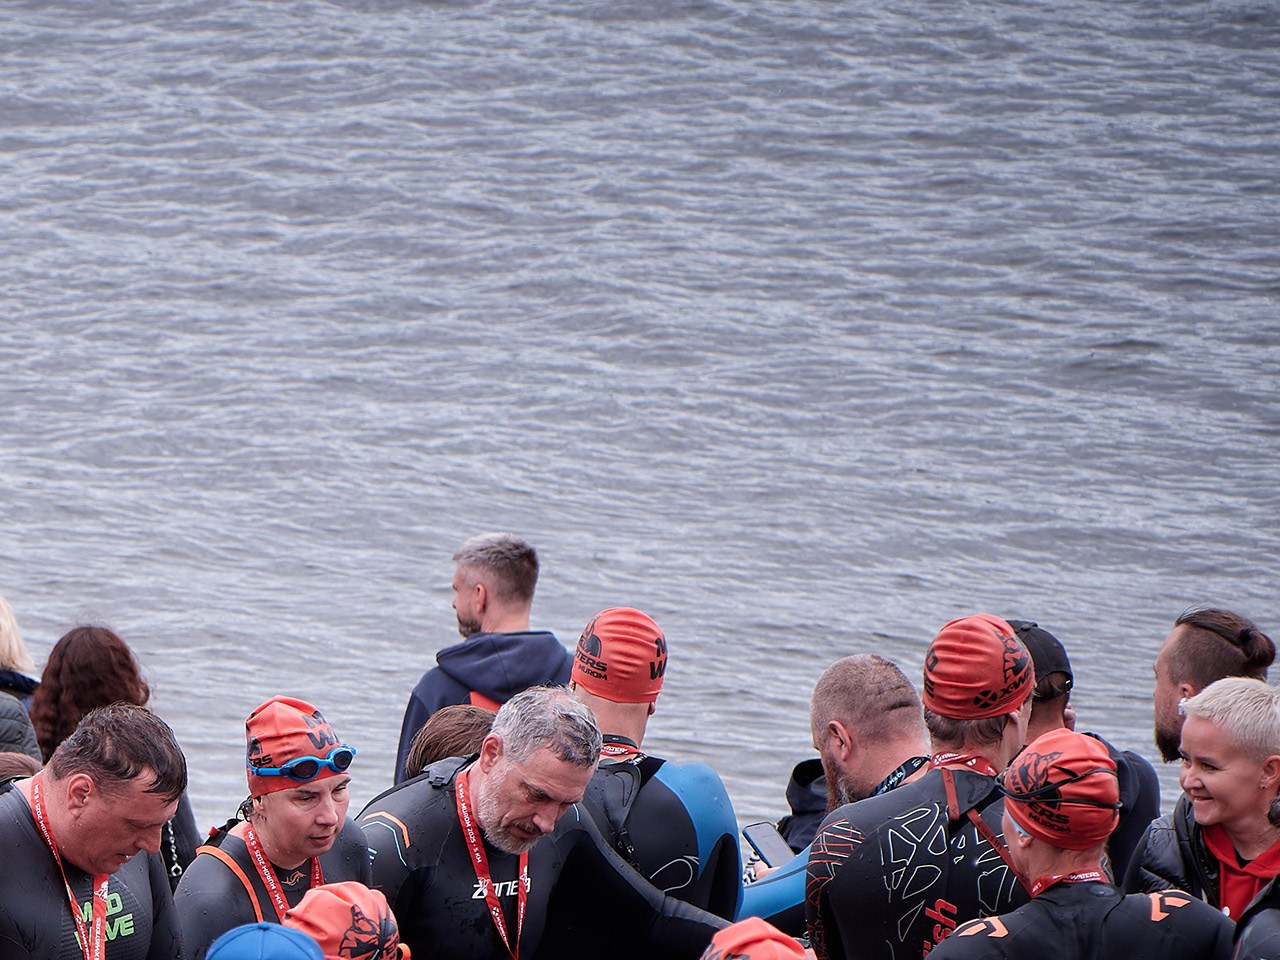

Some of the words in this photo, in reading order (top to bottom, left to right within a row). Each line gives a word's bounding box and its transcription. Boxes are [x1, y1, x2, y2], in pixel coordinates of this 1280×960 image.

[460, 802, 471, 827] MUROM
[467, 827, 476, 844] 2025
[254, 849, 265, 865] 2025
[261, 865, 277, 889] MUROM
